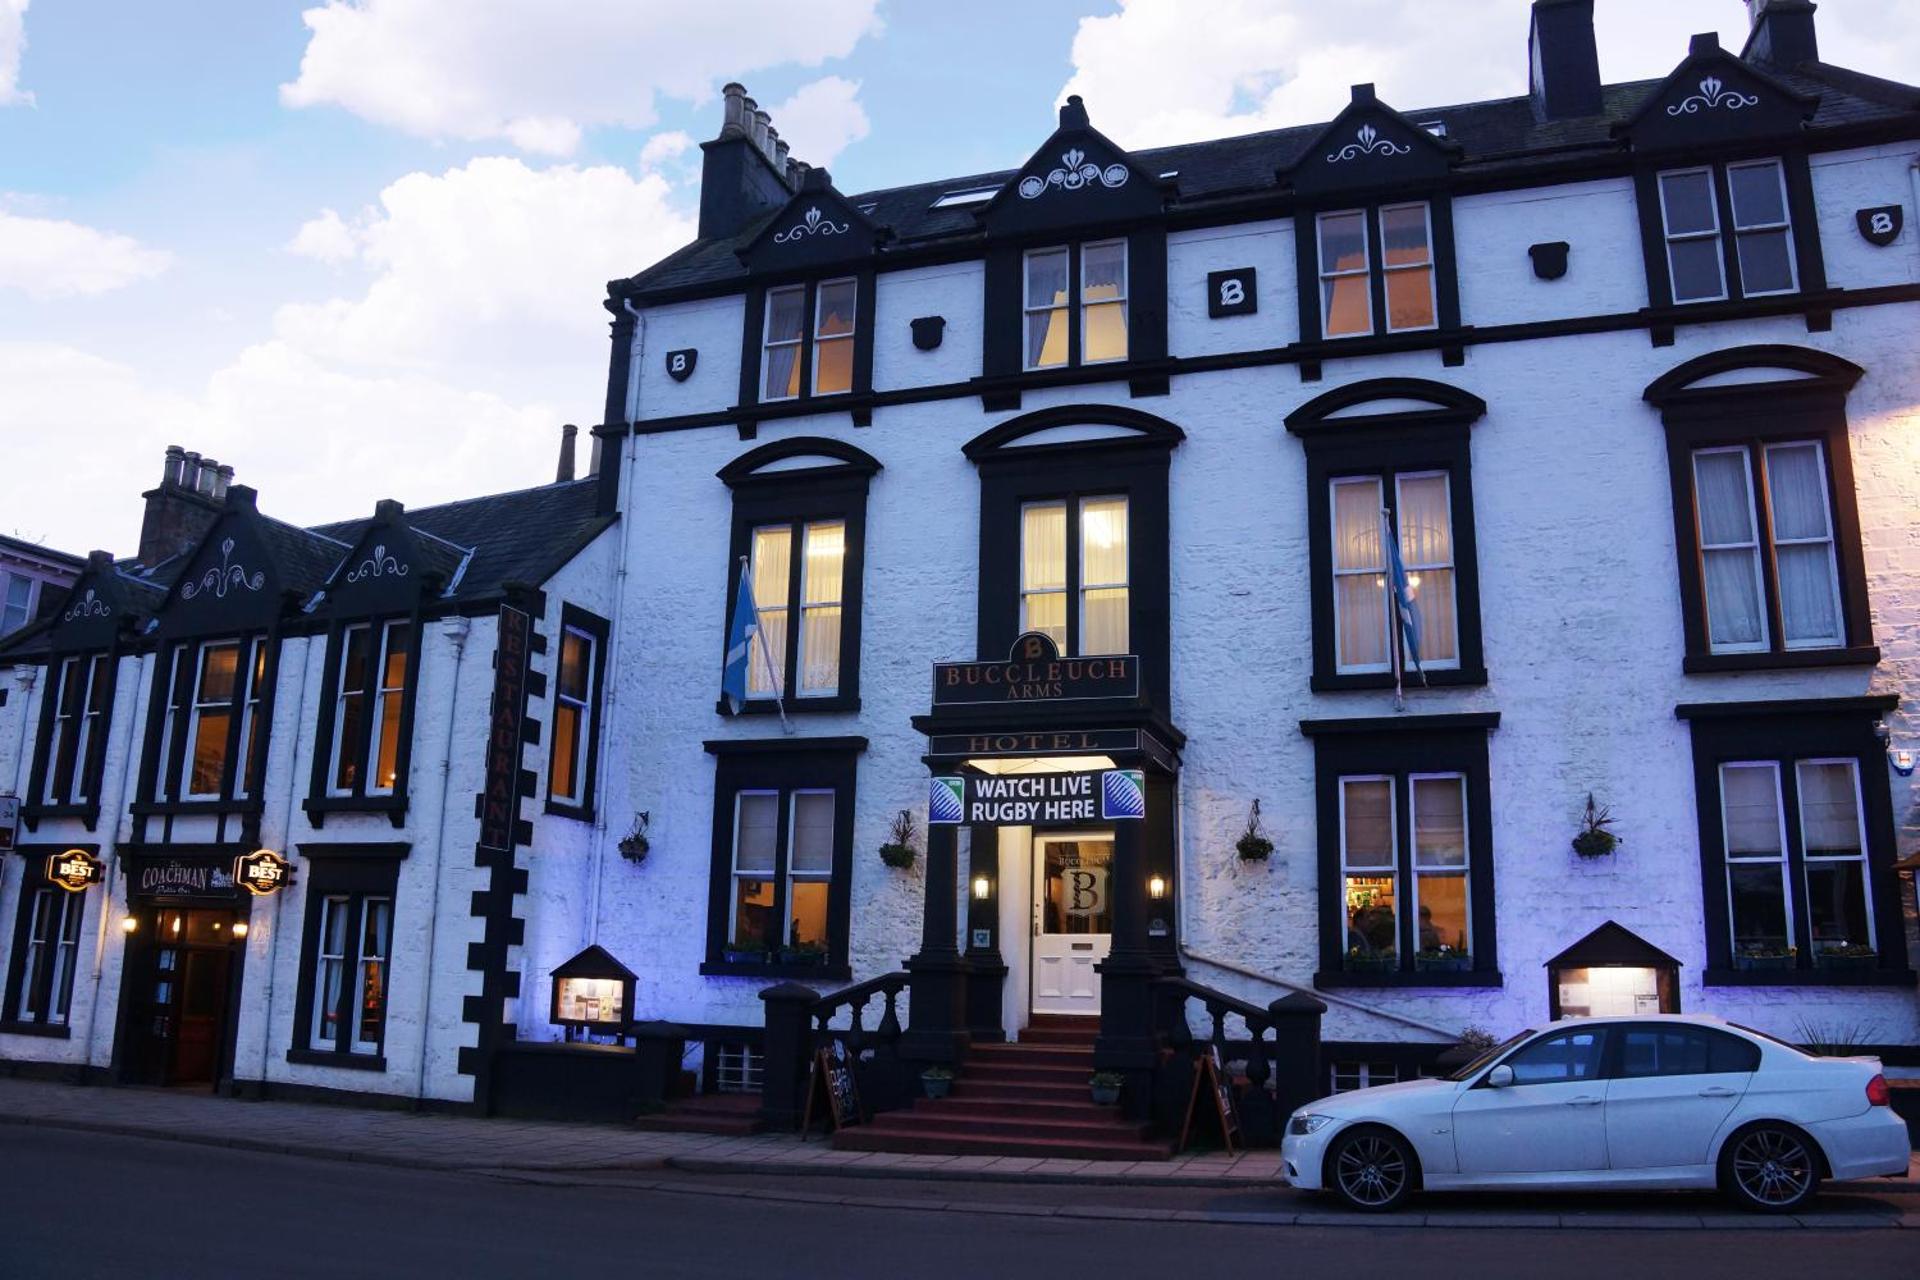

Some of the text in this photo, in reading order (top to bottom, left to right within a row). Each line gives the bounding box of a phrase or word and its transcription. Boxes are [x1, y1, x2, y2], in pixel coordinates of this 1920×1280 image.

[1024, 638, 1043, 659] B
[946, 659, 1127, 686] BUCCLEUCH
[1006, 683, 1063, 699] ARMS
[486, 611, 524, 847] RESTAURANT
[968, 734, 1098, 752] HOTEL
[975, 776, 1092, 798] WATCH LIVE
[971, 799, 1095, 822] RUGBY HERE
[60, 863, 95, 878] BEST
[142, 867, 208, 891] COACHMAN
[248, 864, 283, 880] BEST
[1070, 871, 1098, 910] B
